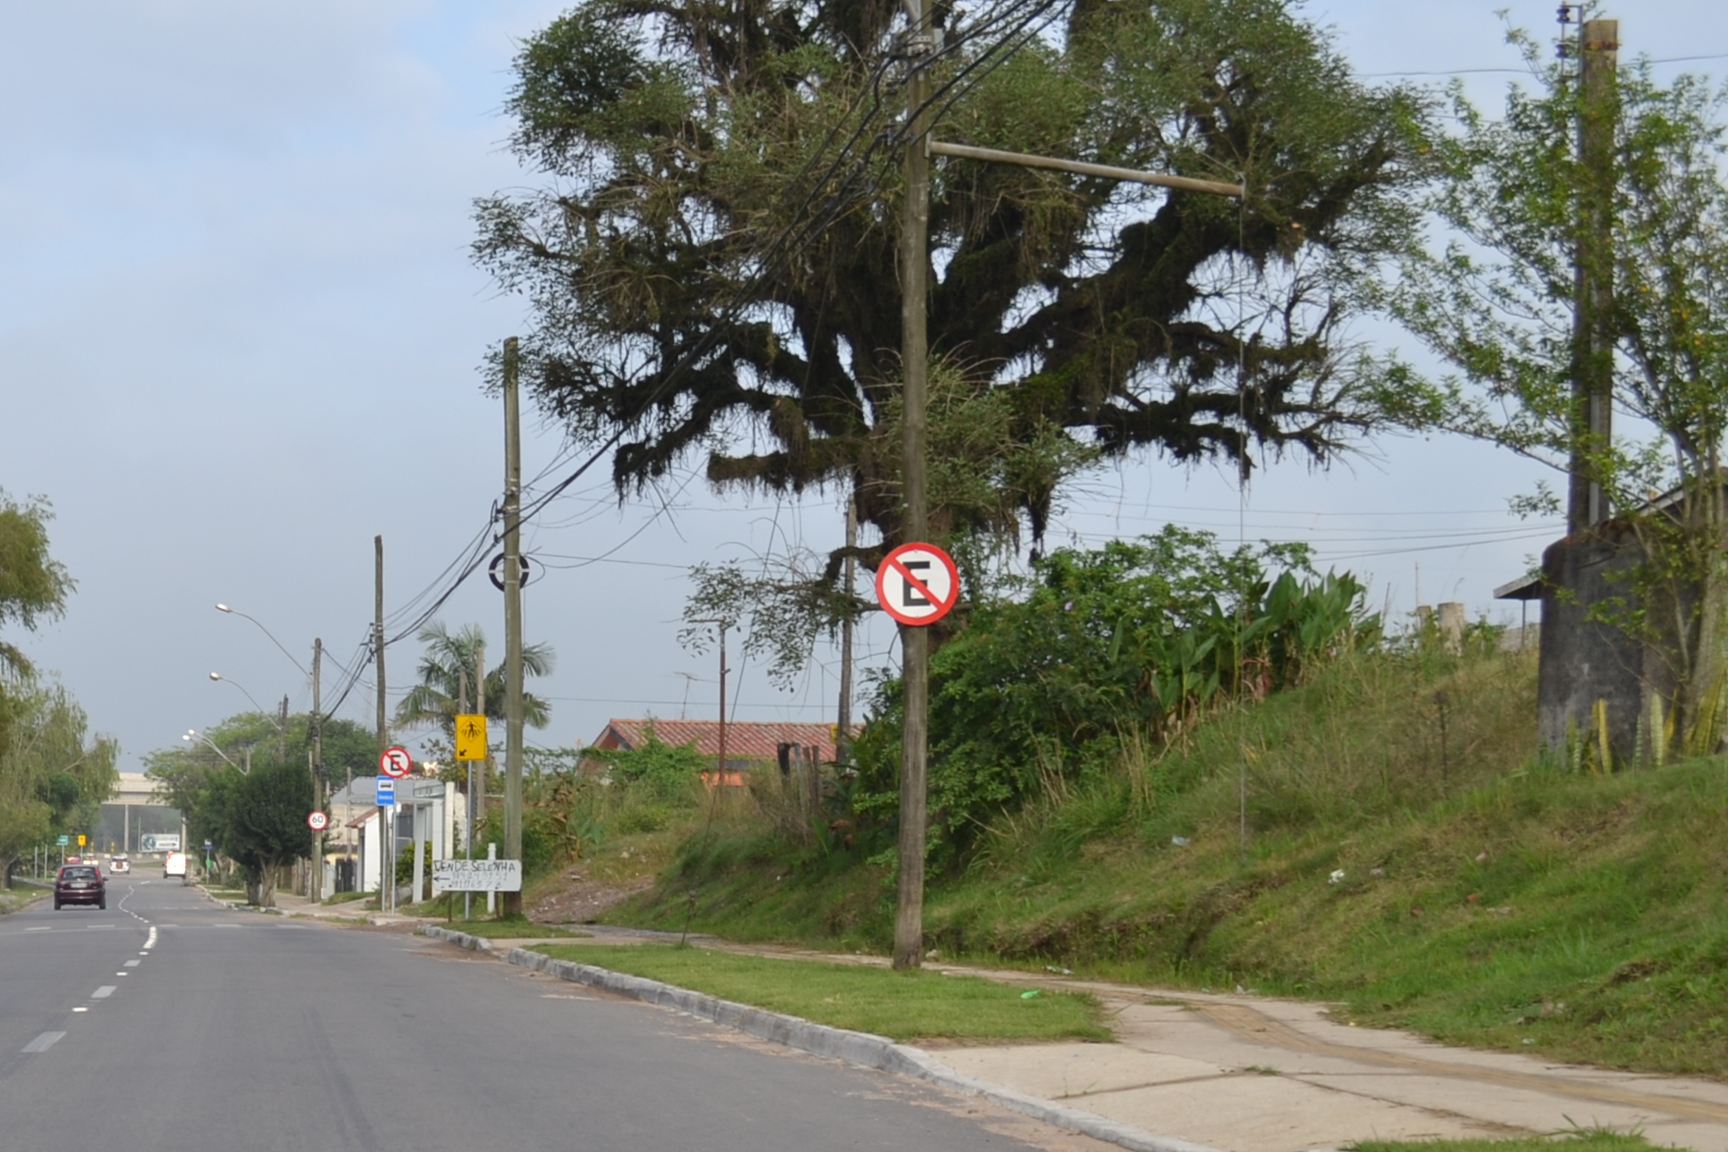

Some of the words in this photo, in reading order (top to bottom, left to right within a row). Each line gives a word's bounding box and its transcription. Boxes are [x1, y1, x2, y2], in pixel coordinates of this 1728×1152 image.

[903, 561, 930, 607] E
[390, 754, 401, 771] E
[312, 815, 323, 824] 60
